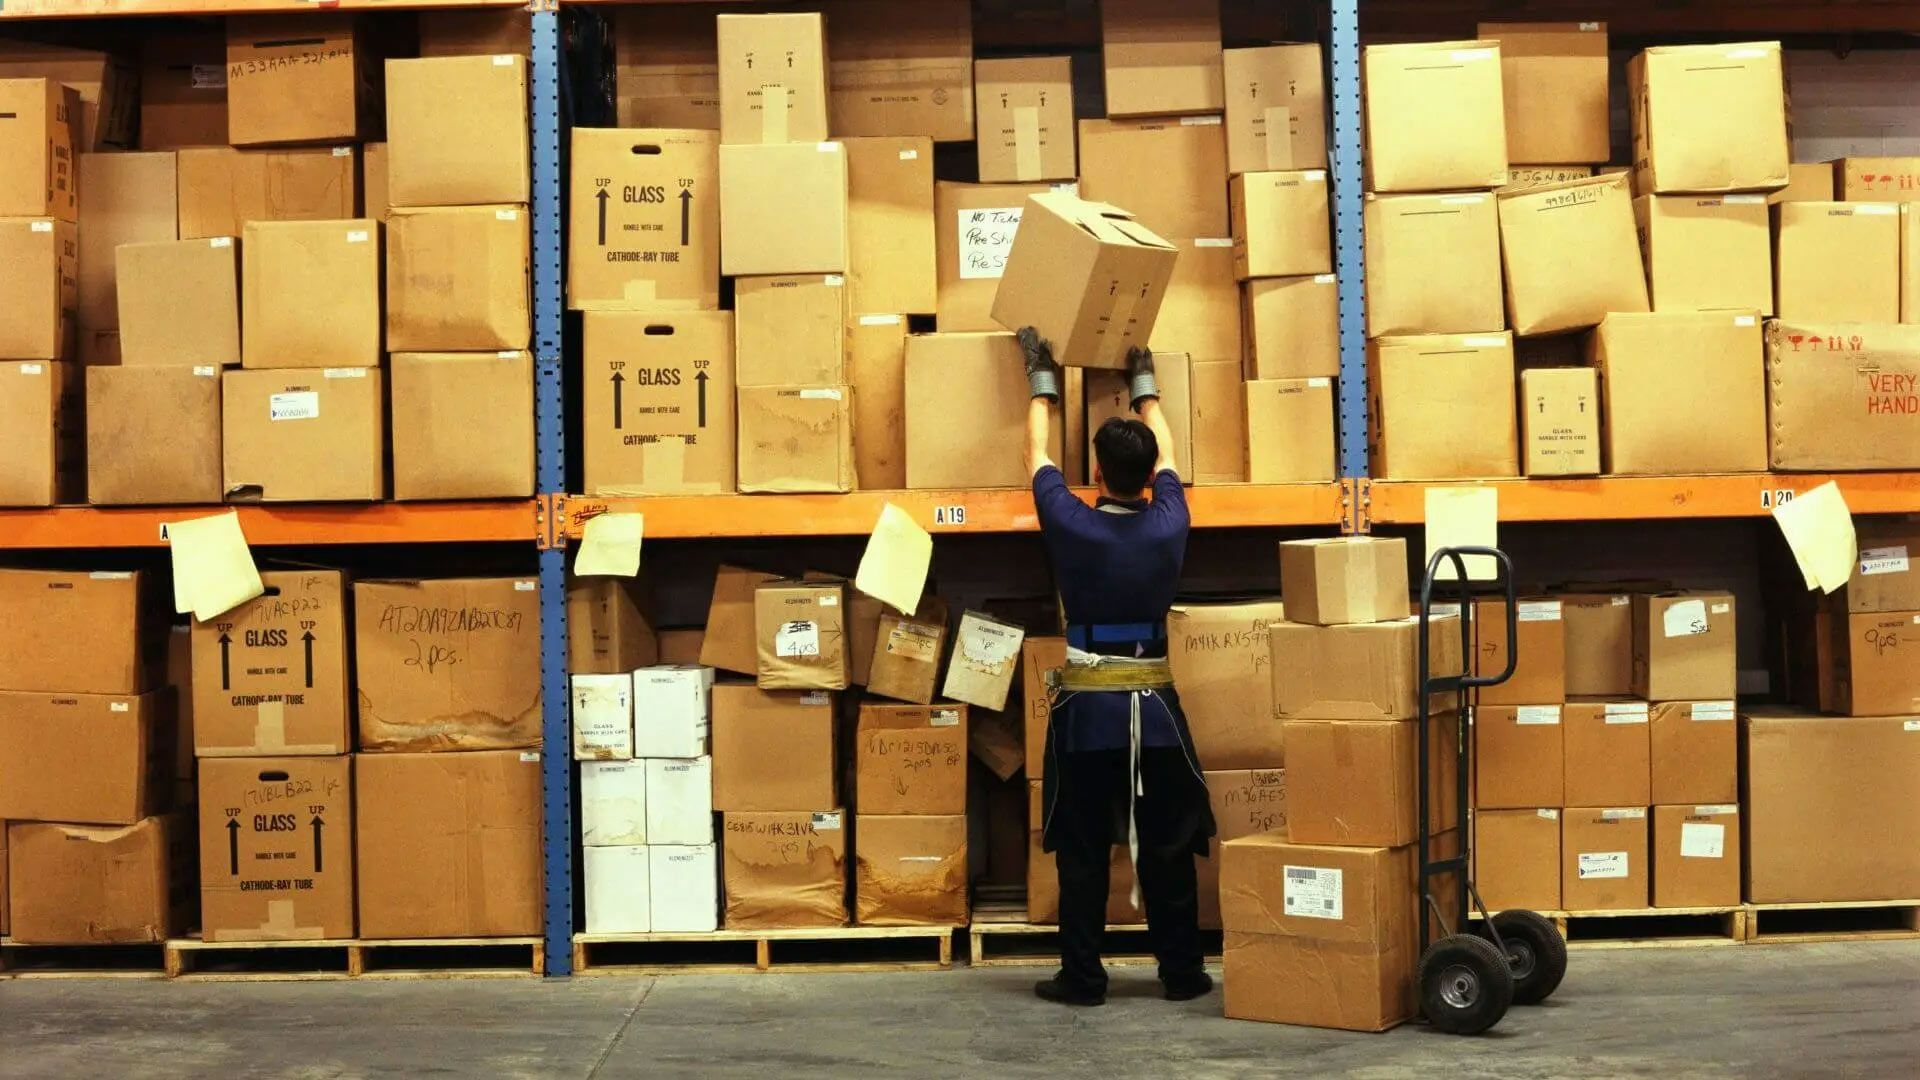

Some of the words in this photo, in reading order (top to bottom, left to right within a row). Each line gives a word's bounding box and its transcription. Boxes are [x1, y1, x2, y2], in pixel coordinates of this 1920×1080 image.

[595, 178, 611, 187] UP
[678, 179, 694, 188] UP
[623, 185, 665, 204] GLASS
[970, 211, 986, 223] NO
[607, 251, 657, 263] CATHODE-RAY
[660, 251, 680, 263] TUBE
[609, 361, 626, 371] UP
[693, 360, 710, 369] UP
[638, 368, 681, 387] GLASS
[1868, 374, 1916, 392] VERY
[639, 406, 656, 414] HANDLE
[1867, 396, 1919, 415] HAND
[1763, 491, 1770, 507] A
[1777, 491, 1793, 507] 20
[937, 508, 944, 523] A
[950, 507, 964, 523] 19
[161, 524, 169, 540] A
[217, 622, 233, 632] UP
[300, 620, 316, 630] UP
[245, 629, 288, 648] GLASS
[285, 694, 305, 705] TUBE
[225, 808, 241, 817] UP
[309, 805, 325, 814] UP
[254, 814, 297, 832] GLASS
[240, 880, 291, 891] CATHODE-RAY
[293, 879, 313, 890] TUBE
